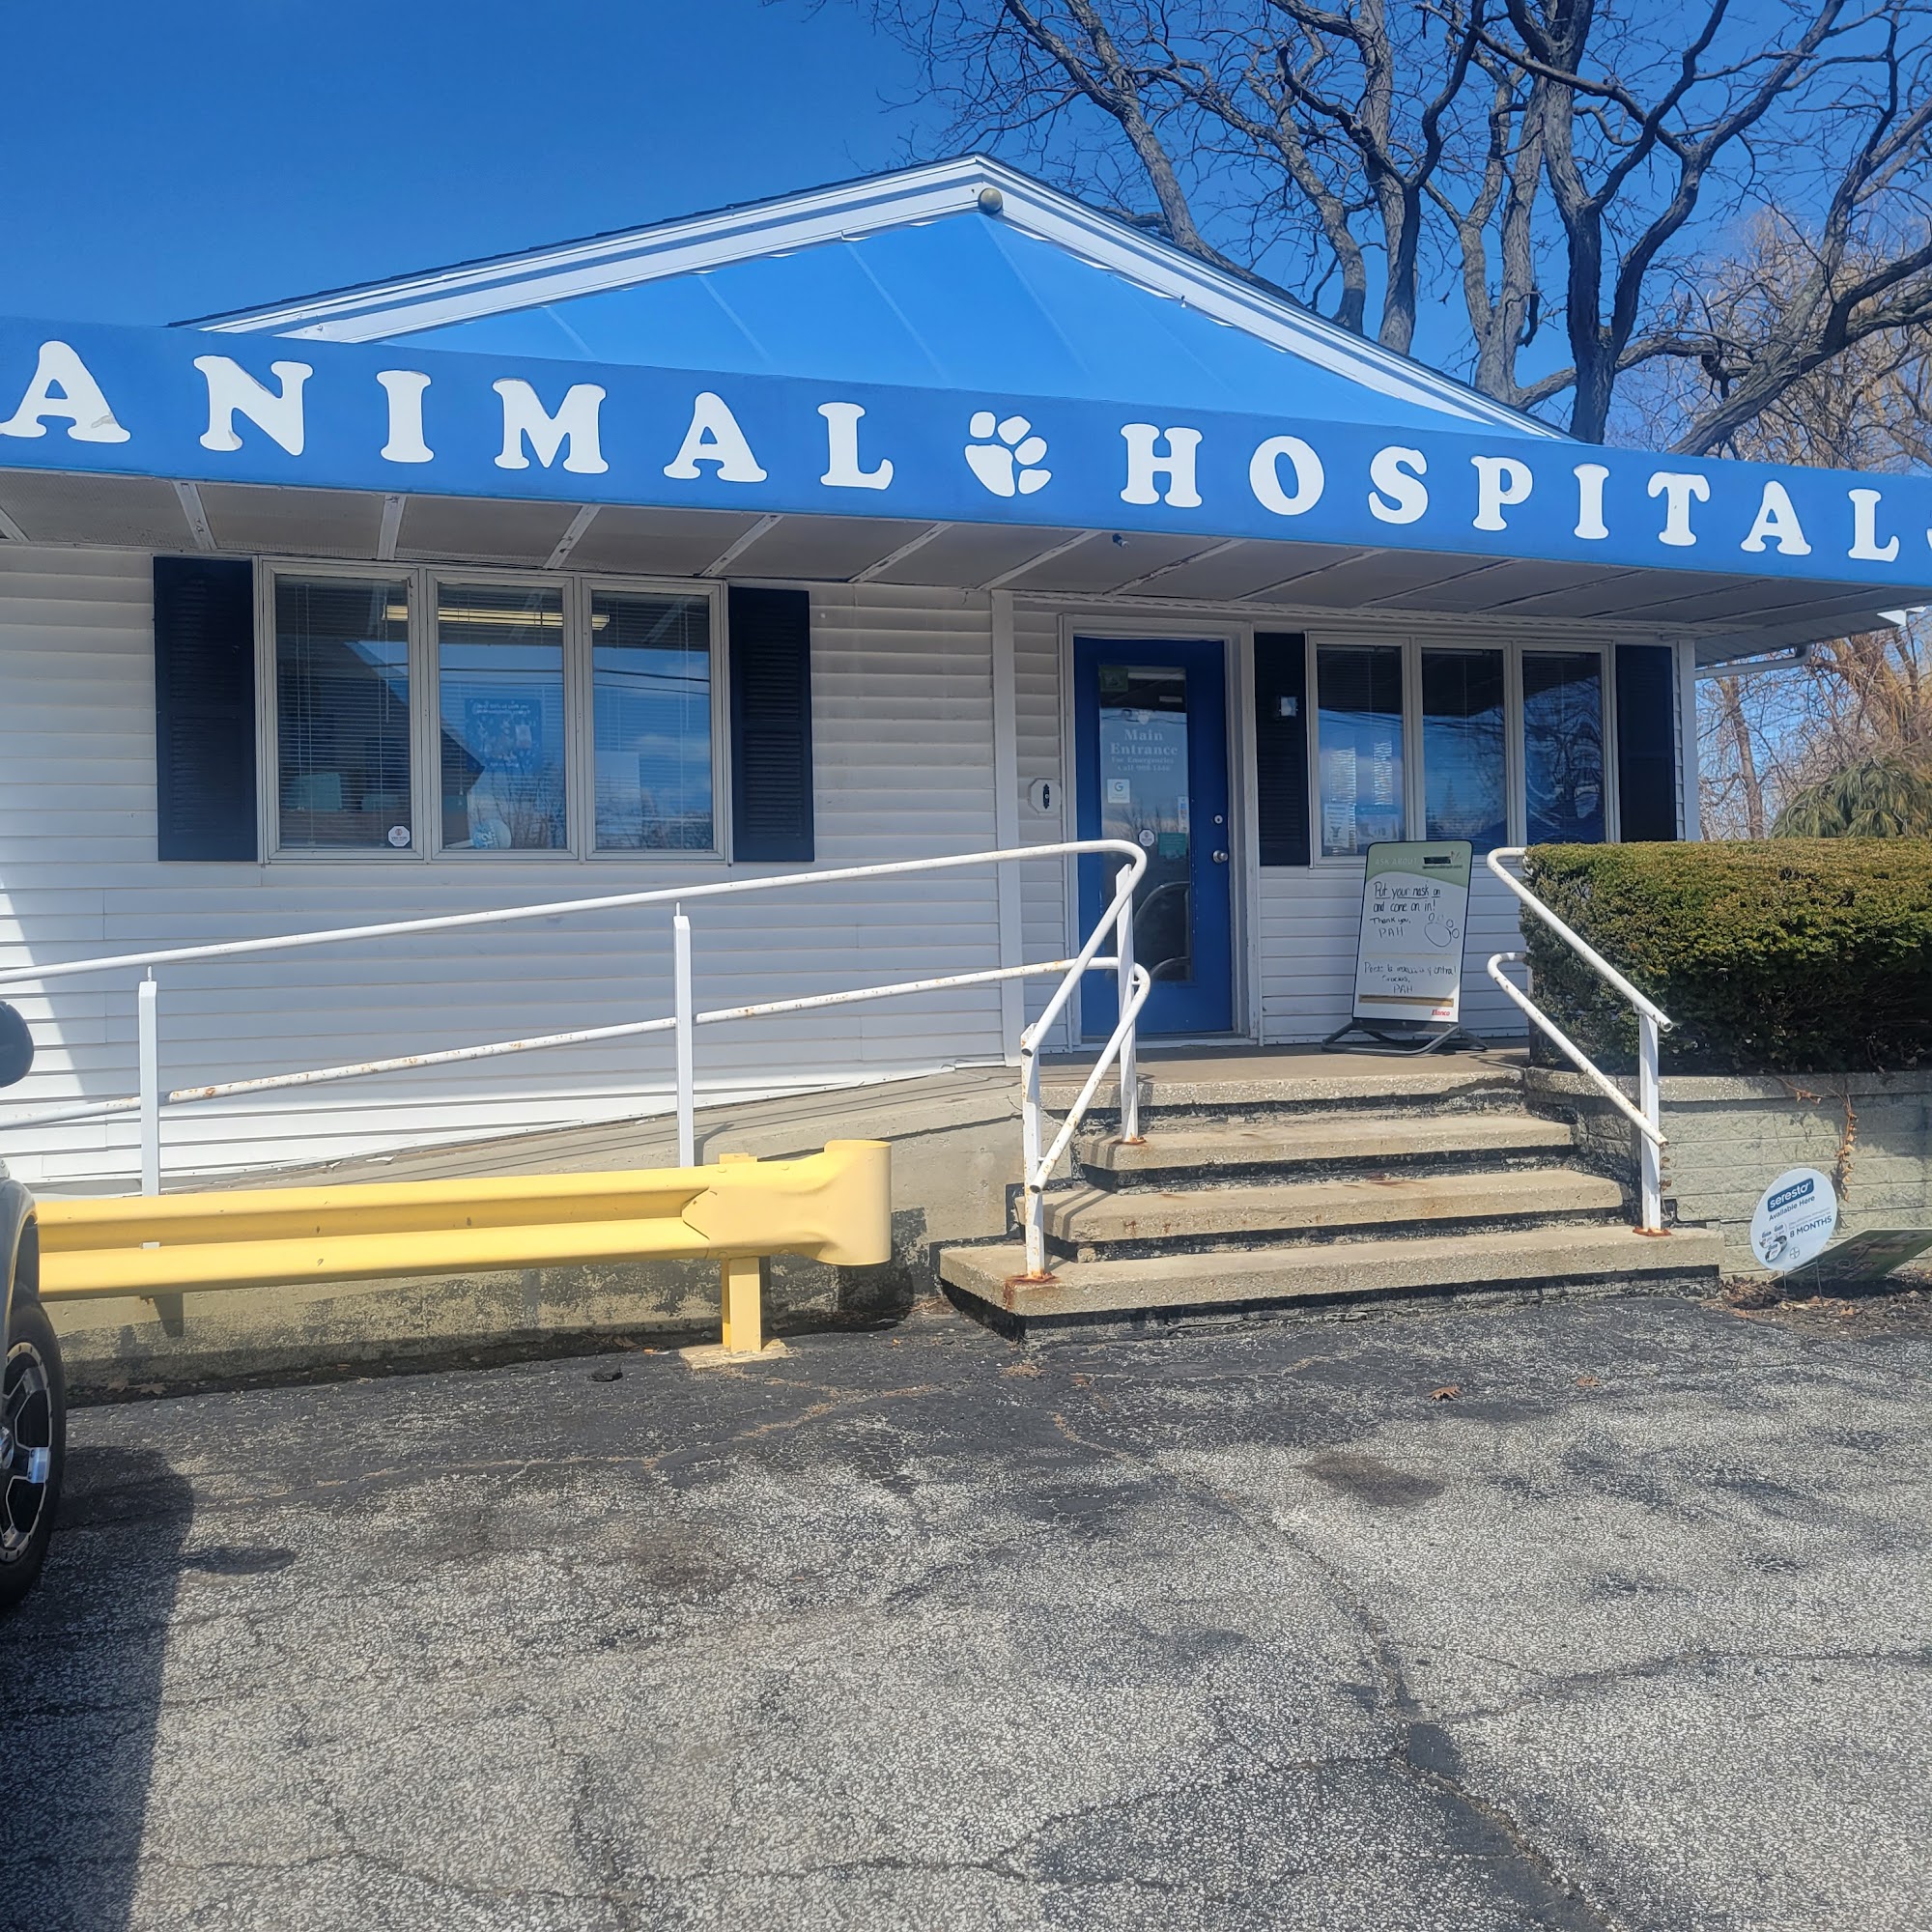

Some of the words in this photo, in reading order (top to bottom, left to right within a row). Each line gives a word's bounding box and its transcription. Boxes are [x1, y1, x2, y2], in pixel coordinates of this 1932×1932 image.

[0, 340, 895, 491] ANIMAL
[1120, 422, 1900, 564] HOSPITAL
[1124, 728, 1163, 741] Main
[1110, 742, 1178, 755] Entrance
[1114, 781, 1124, 792] G
[1375, 857, 1390, 866] ASK
[1392, 856, 1418, 866] ABOUT
[1374, 881, 1388, 897] Put
[1391, 886, 1411, 899] your
[1433, 888, 1441, 896] on
[1373, 900, 1385, 912] and
[1389, 902, 1407, 912] come
[1410, 902, 1420, 912] on
[1424, 898, 1436, 912] in!
[1369, 916, 1396, 924] Thank
[1378, 925, 1404, 939] PAH
[1393, 984, 1413, 995] PAH
[1769, 1203, 1798, 1221] Available
[1799, 1195, 1816, 1207] Here
[1789, 1230, 1795, 1238] 8
[1797, 1215, 1833, 1236] MONTHS
